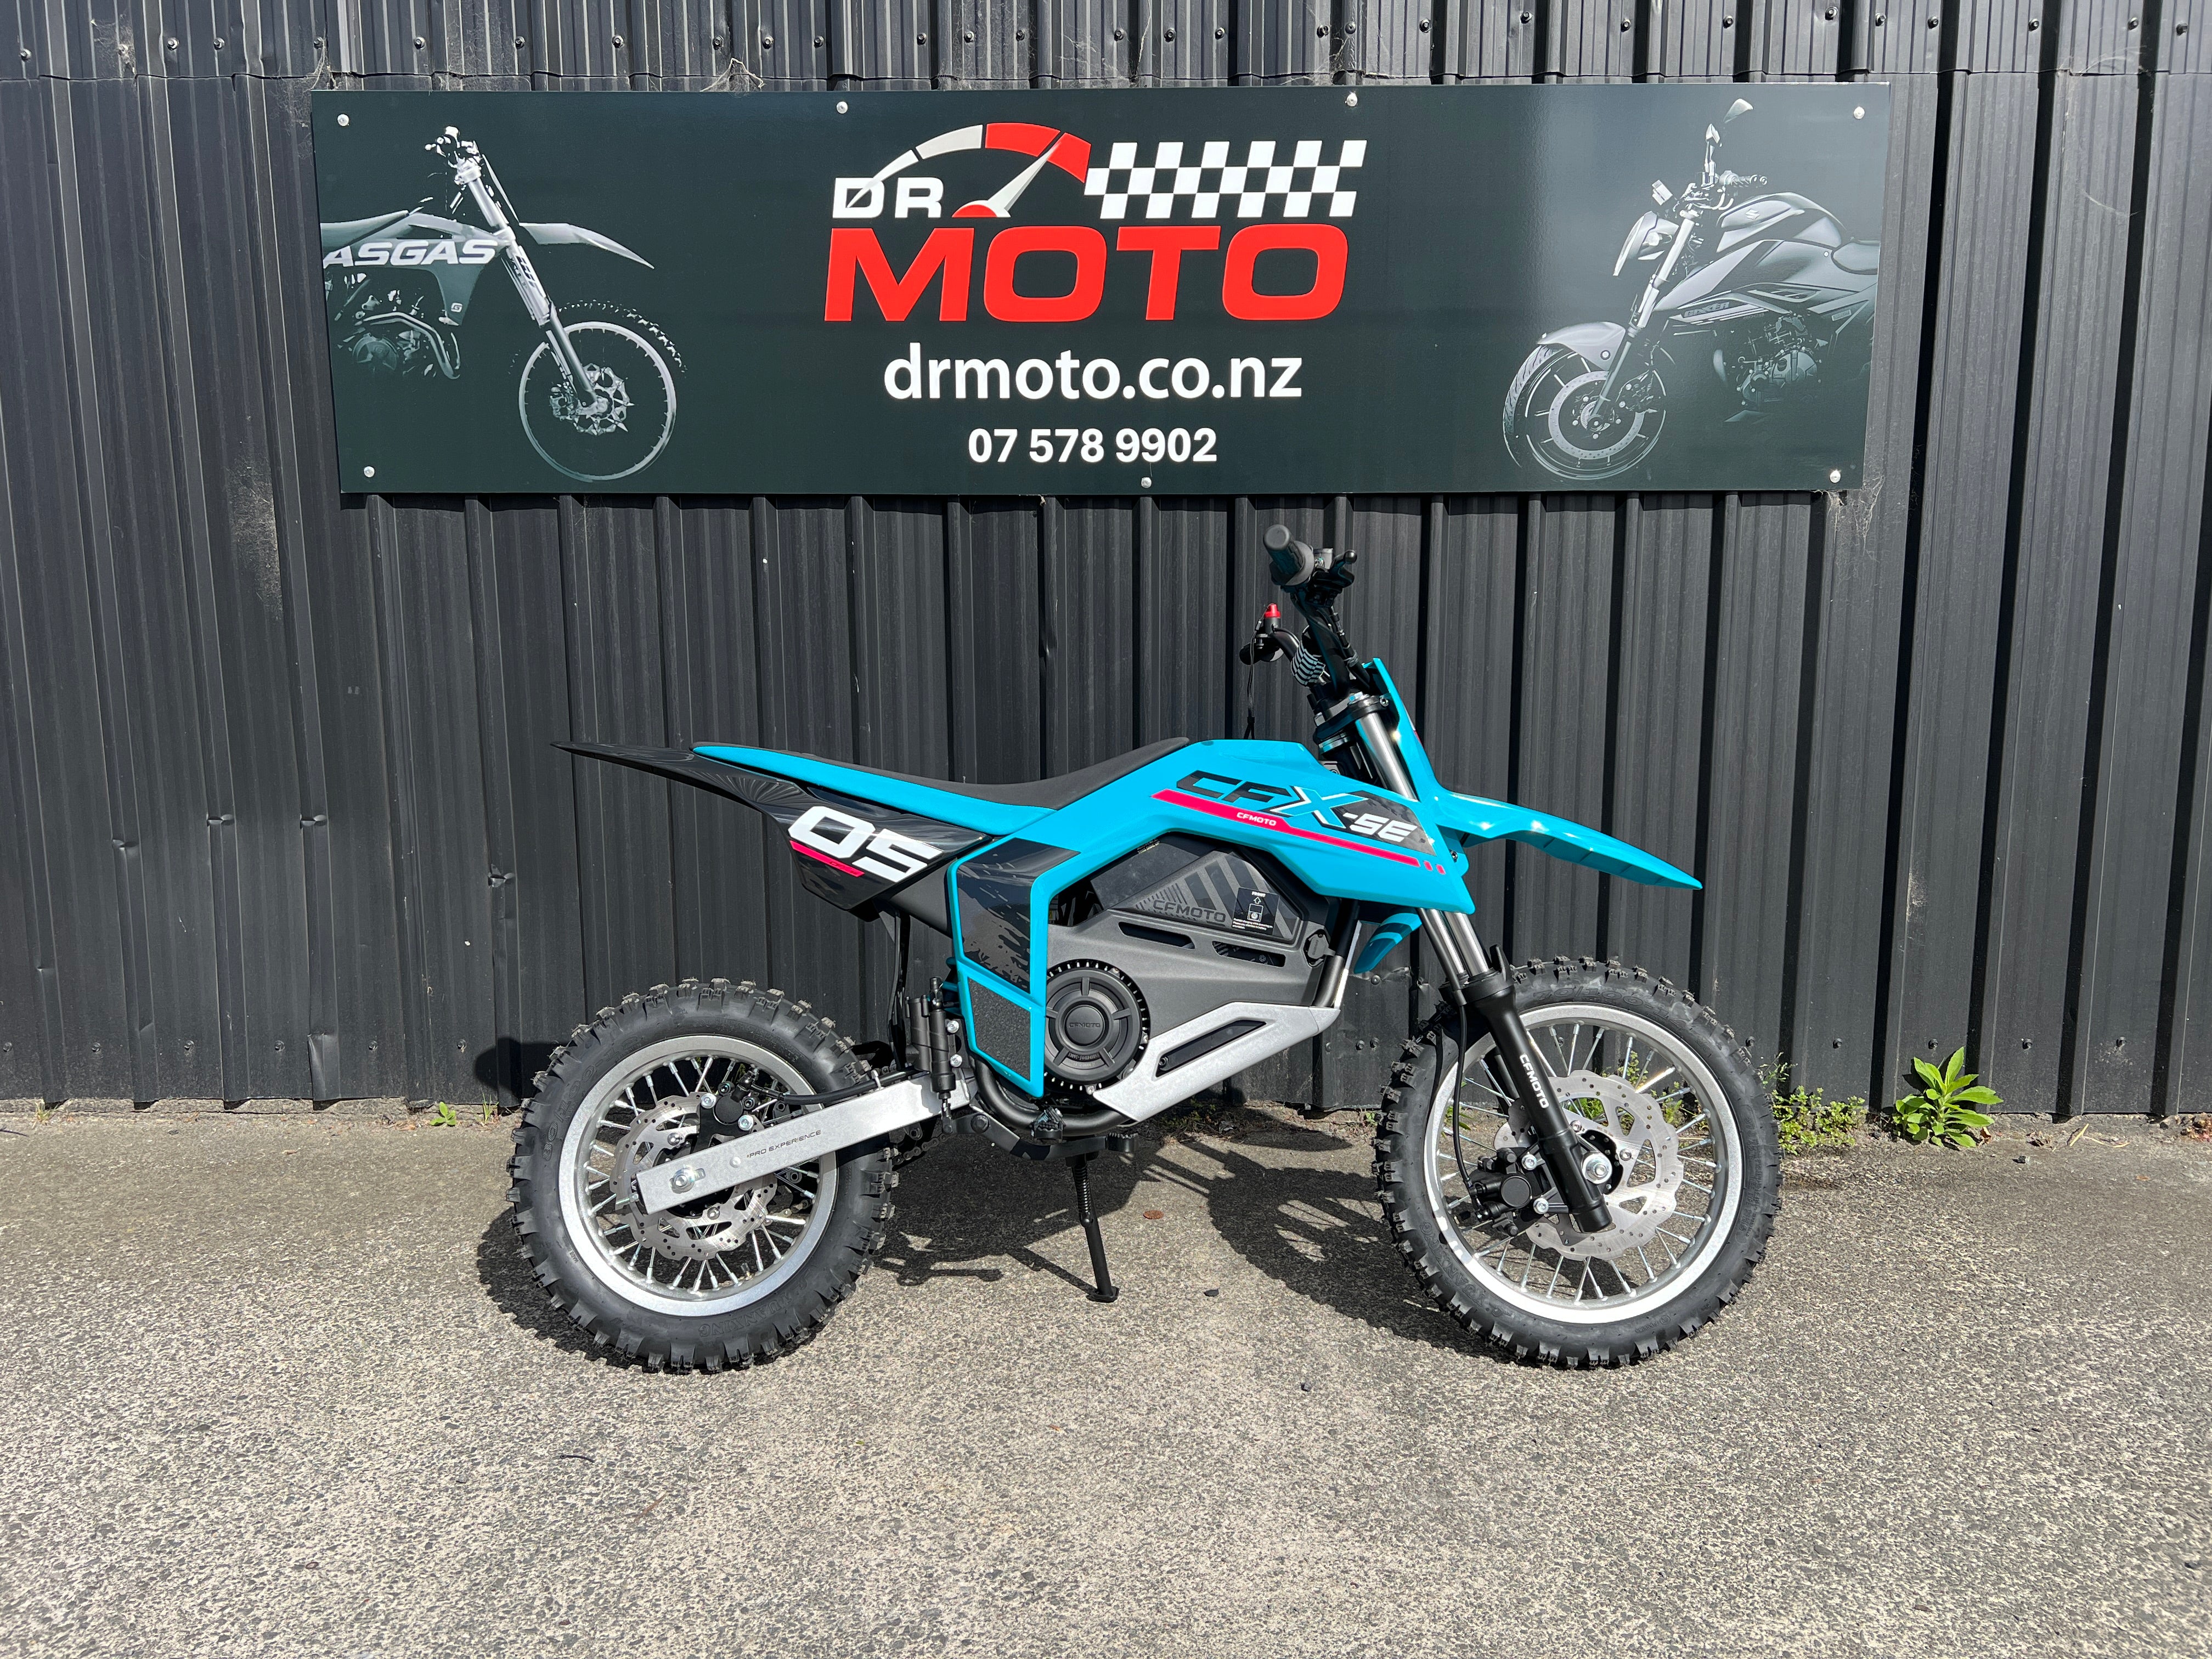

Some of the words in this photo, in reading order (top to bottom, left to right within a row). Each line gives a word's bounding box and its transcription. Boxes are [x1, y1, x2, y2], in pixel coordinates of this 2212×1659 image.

[832, 177, 944, 218] DR
[825, 223, 1348, 323] MOTO
[1684, 302, 1730, 317] GIXXER
[884, 342, 1302, 399] drmoto.co.nz
[968, 428, 1018, 463] 07
[1029, 428, 1105, 463] 578
[1115, 428, 1217, 462] 9902
[1236, 812, 1277, 826] CFMOTO
[1153, 900, 1226, 923] CFMOTO
[1519, 1054, 1549, 1108] CFMOTO
[749, 1148, 766, 1158] PRO
[769, 1130, 821, 1152] EXPERIENCE
[697, 1290, 793, 1338] YUANXING
